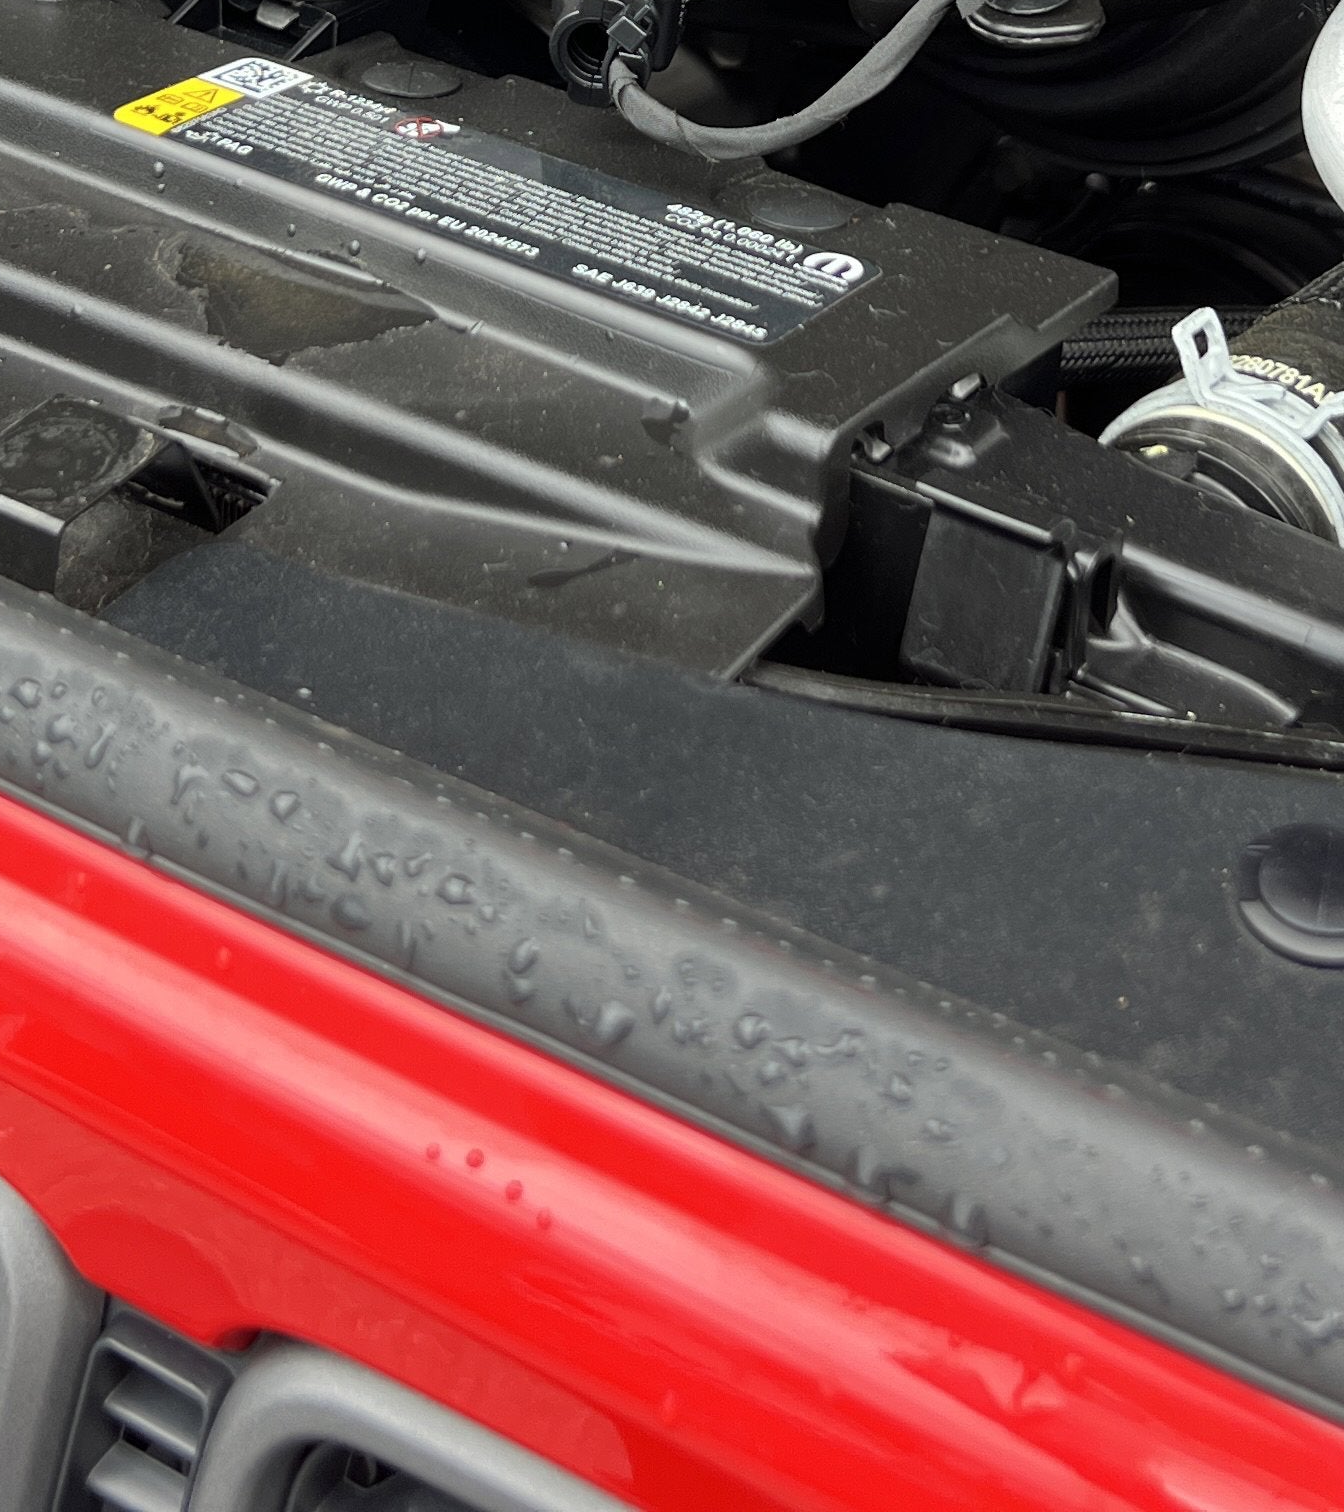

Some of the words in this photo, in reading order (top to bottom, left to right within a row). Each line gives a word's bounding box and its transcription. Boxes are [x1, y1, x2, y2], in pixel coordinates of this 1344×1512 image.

[313, 173, 358, 192] GWP
[371, 193, 411, 211] CO2
[405, 206, 439, 222] per
[437, 216, 467, 231] EU
[464, 226, 540, 258] 2024/573
[571, 263, 614, 283] SAE
[612, 278, 657, 299] J639
